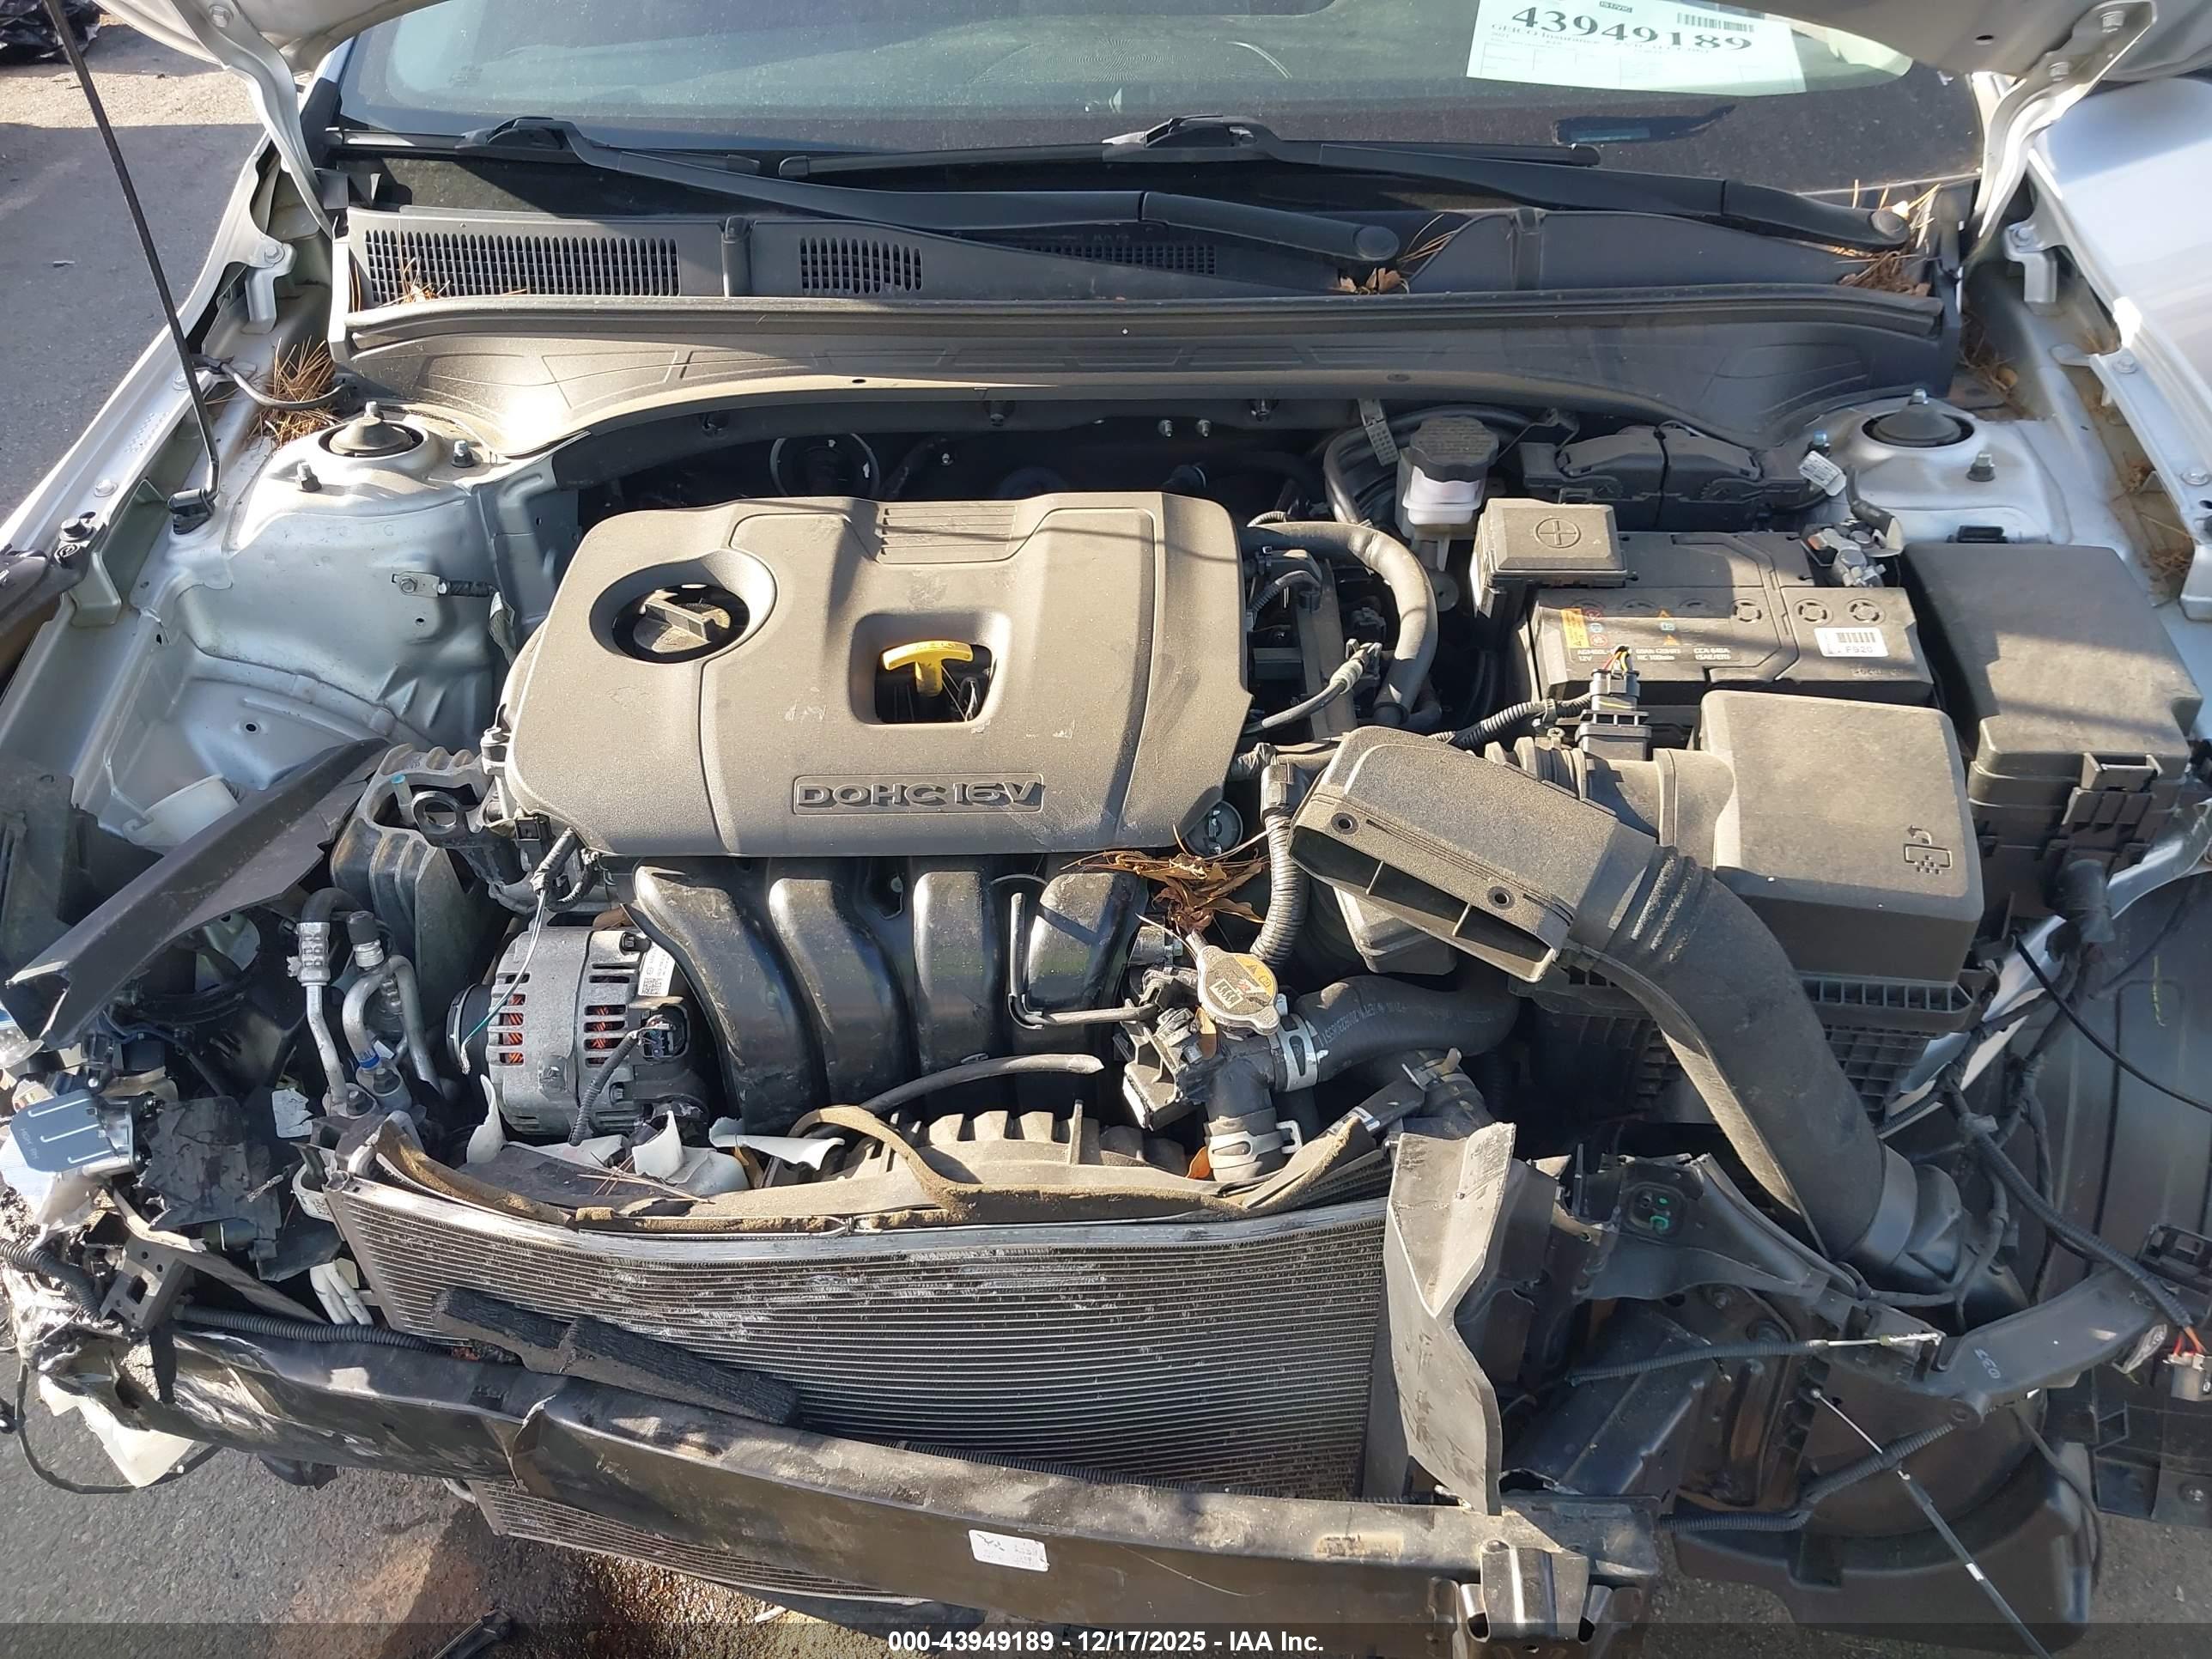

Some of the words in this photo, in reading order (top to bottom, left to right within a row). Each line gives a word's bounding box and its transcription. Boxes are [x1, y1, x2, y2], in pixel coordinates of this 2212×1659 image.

[1492, 24, 1539, 36] GEICO
[1512, 7, 1753, 50] 43949189
[797, 783, 946, 807] DOHC
[952, 781, 1045, 806] 16V
